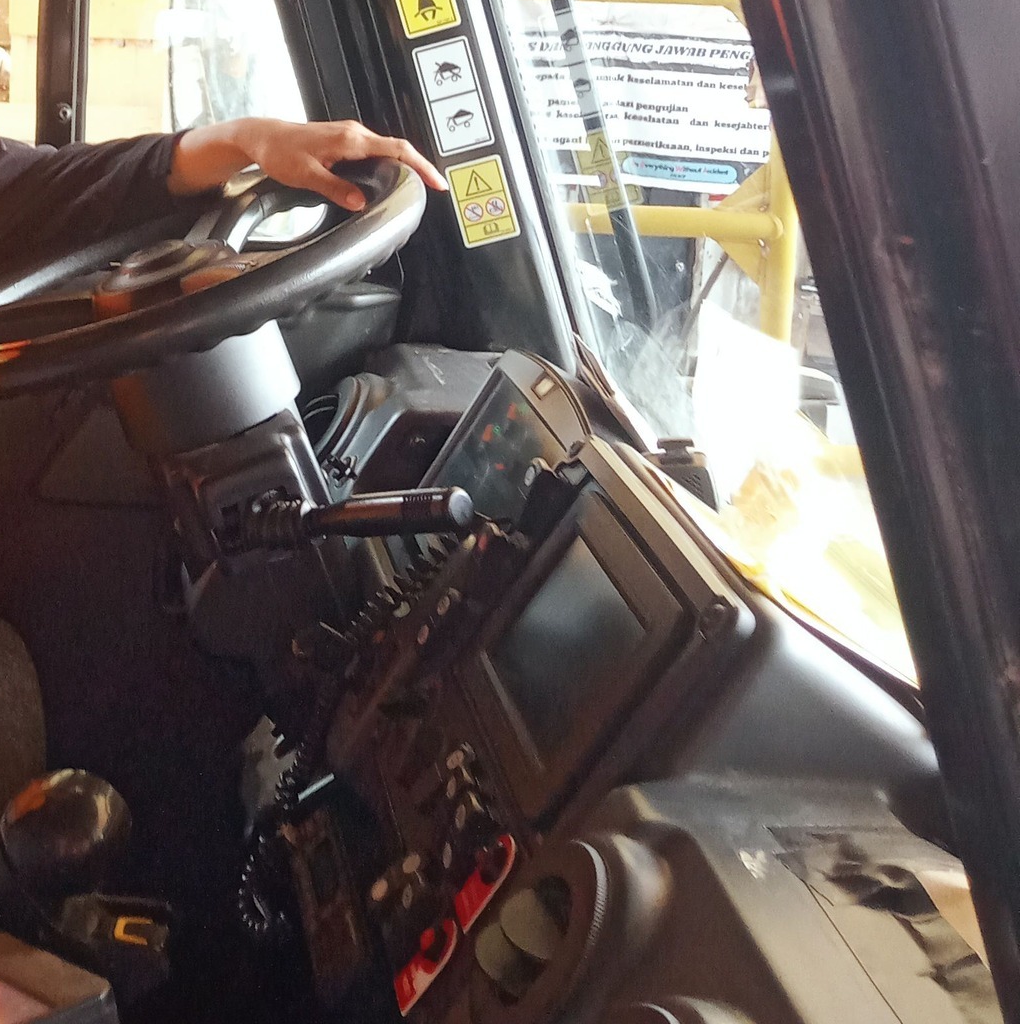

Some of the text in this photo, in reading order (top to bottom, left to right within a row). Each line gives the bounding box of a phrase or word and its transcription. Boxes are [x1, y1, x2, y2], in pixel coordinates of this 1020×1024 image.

[655, 44, 707, 57] JAWAB
[709, 48, 753, 61] PENG
[627, 73, 694, 87] keselamatan
[697, 80, 716, 89] dan
[636, 102, 689, 114] pengujian
[624, 111, 680, 125] kesehatan
[690, 118, 709, 127] dan
[714, 120, 770, 131] kesejahter
[623, 138, 693, 152] pemeriksaan,
[695, 143, 737, 155] inspeksi
[740, 148, 759, 156] dan
